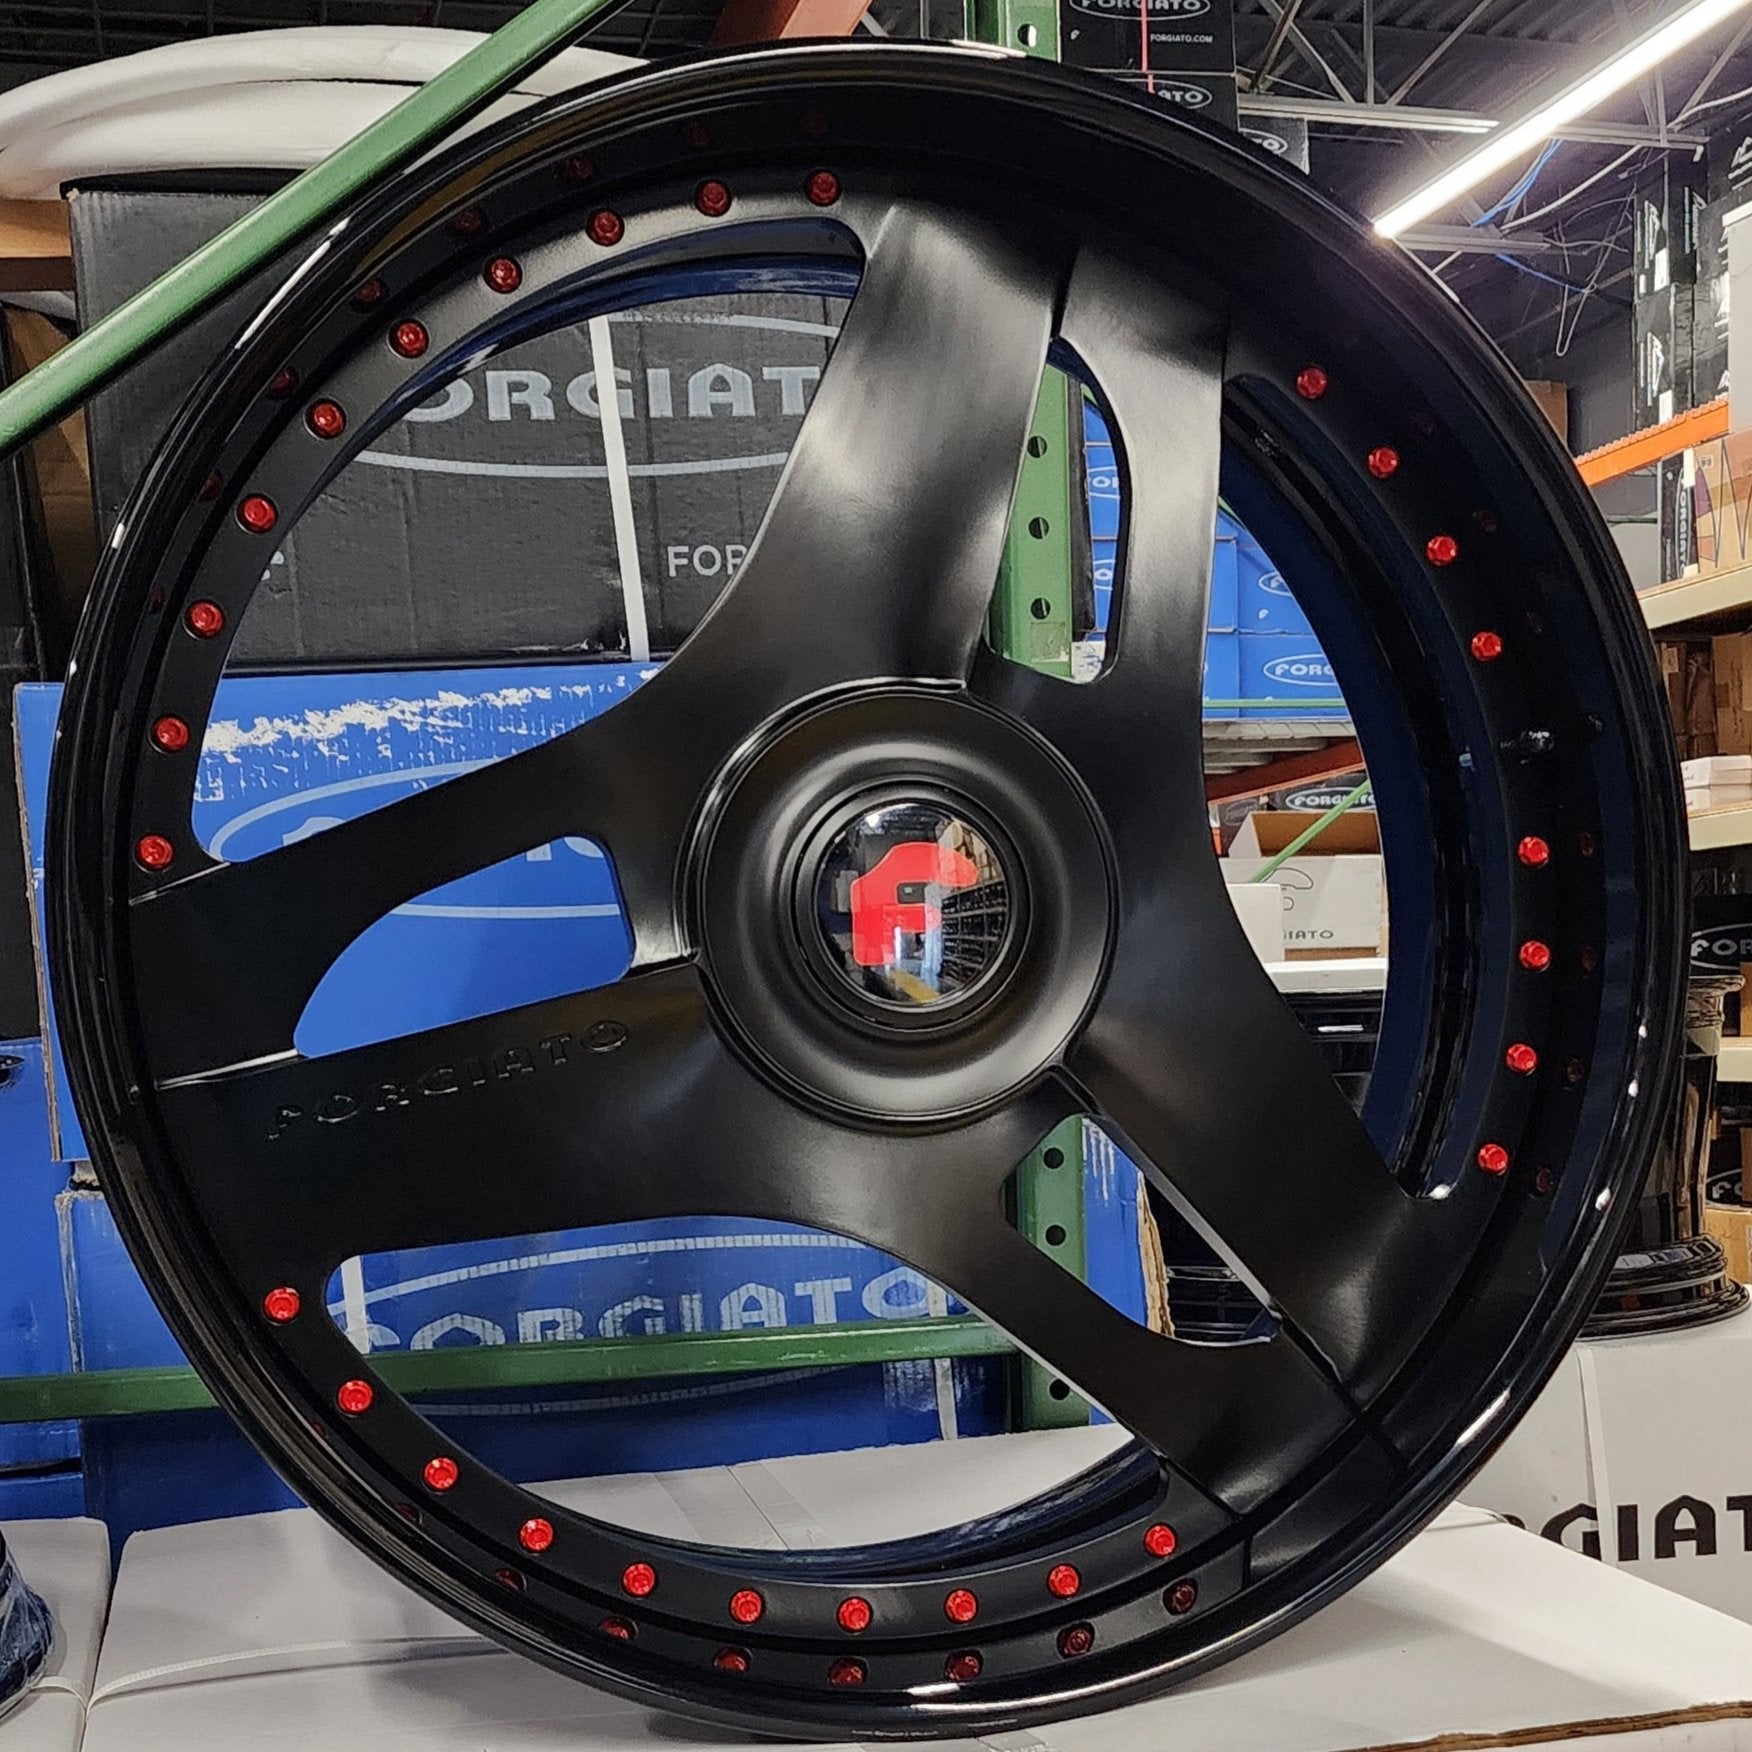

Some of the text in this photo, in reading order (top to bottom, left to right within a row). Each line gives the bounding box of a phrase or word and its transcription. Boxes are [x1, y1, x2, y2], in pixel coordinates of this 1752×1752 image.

[1150, 34, 1213, 43] FORGIATO.COM
[1284, 929, 1334, 940] IATO
[268, 1020, 630, 1140] FORGIATO
